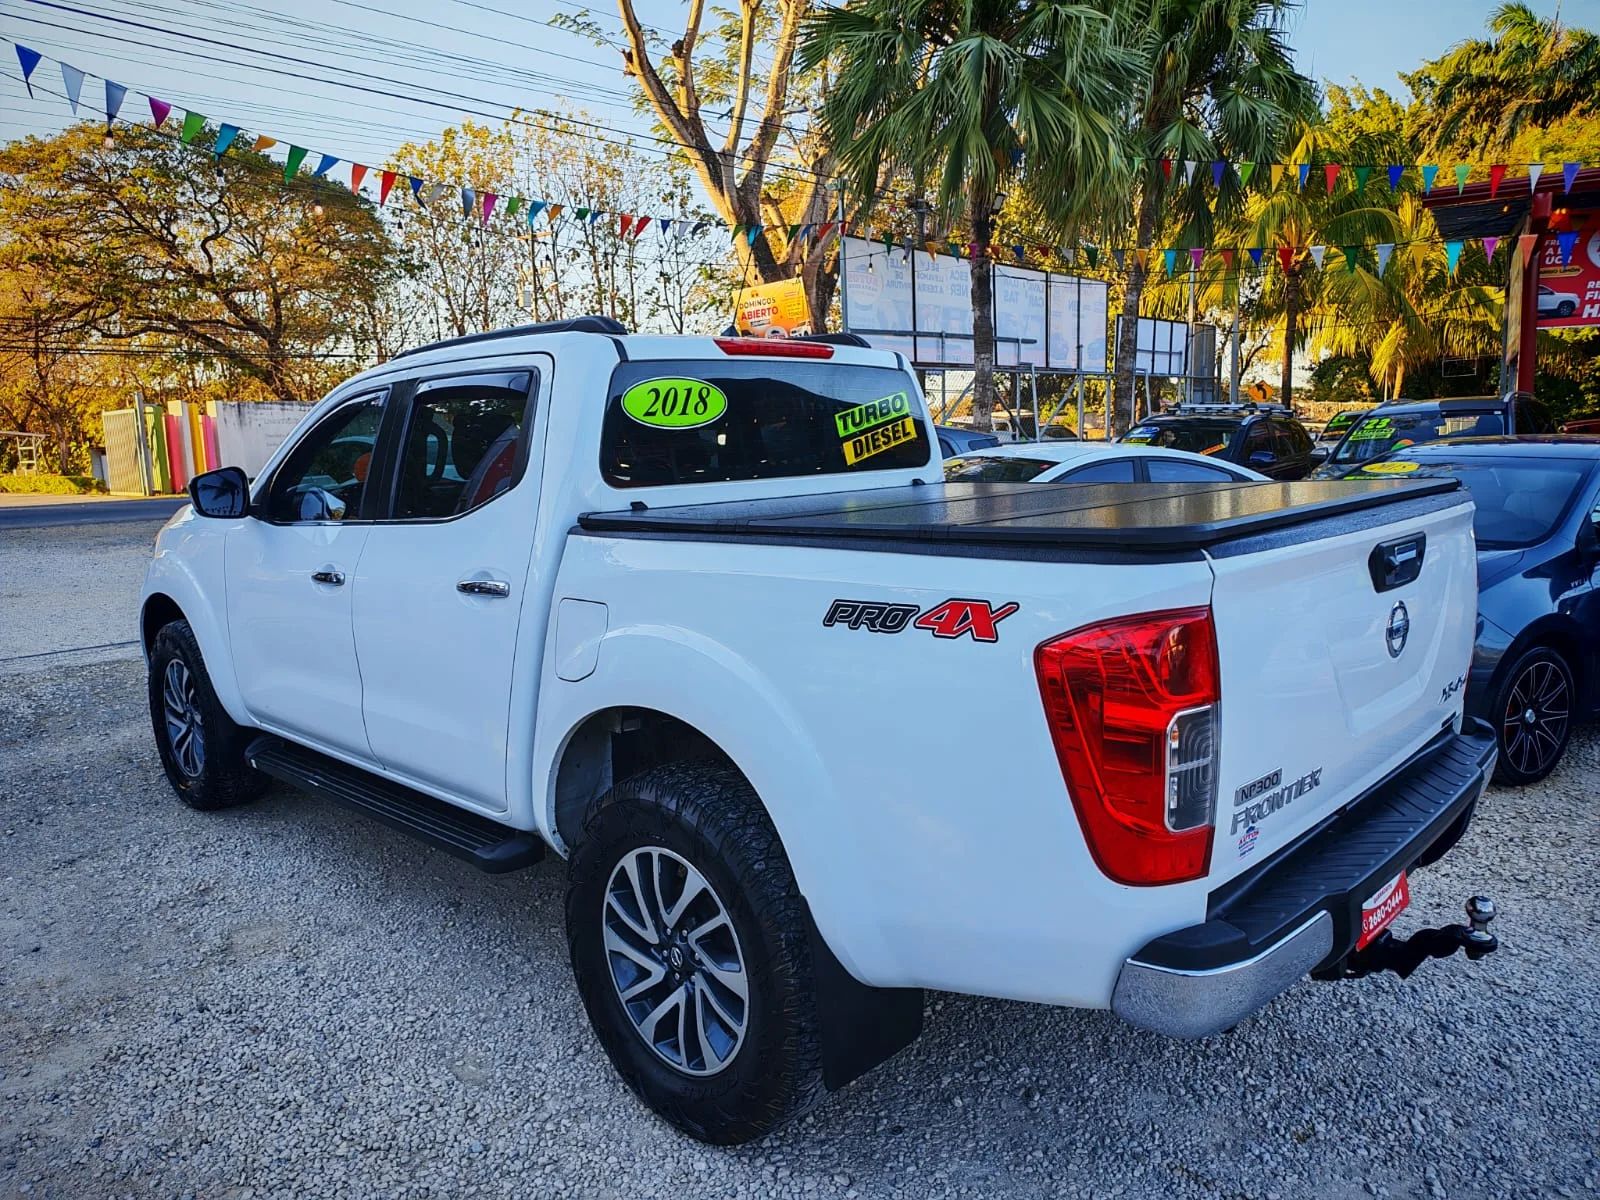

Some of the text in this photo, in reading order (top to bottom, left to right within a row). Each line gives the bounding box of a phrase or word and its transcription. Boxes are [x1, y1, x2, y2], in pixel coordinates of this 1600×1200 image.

[739, 297, 776, 310] DOMINGOS
[741, 306, 778, 321] ABIERTO
[643, 386, 711, 417] 2018
[838, 394, 905, 432] TURBO
[851, 421, 911, 460] DIESEL
[1230, 767, 1322, 836] FRONTIER
[1241, 772, 1280, 802] NP300
[1368, 887, 1403, 930] 2680-0444
